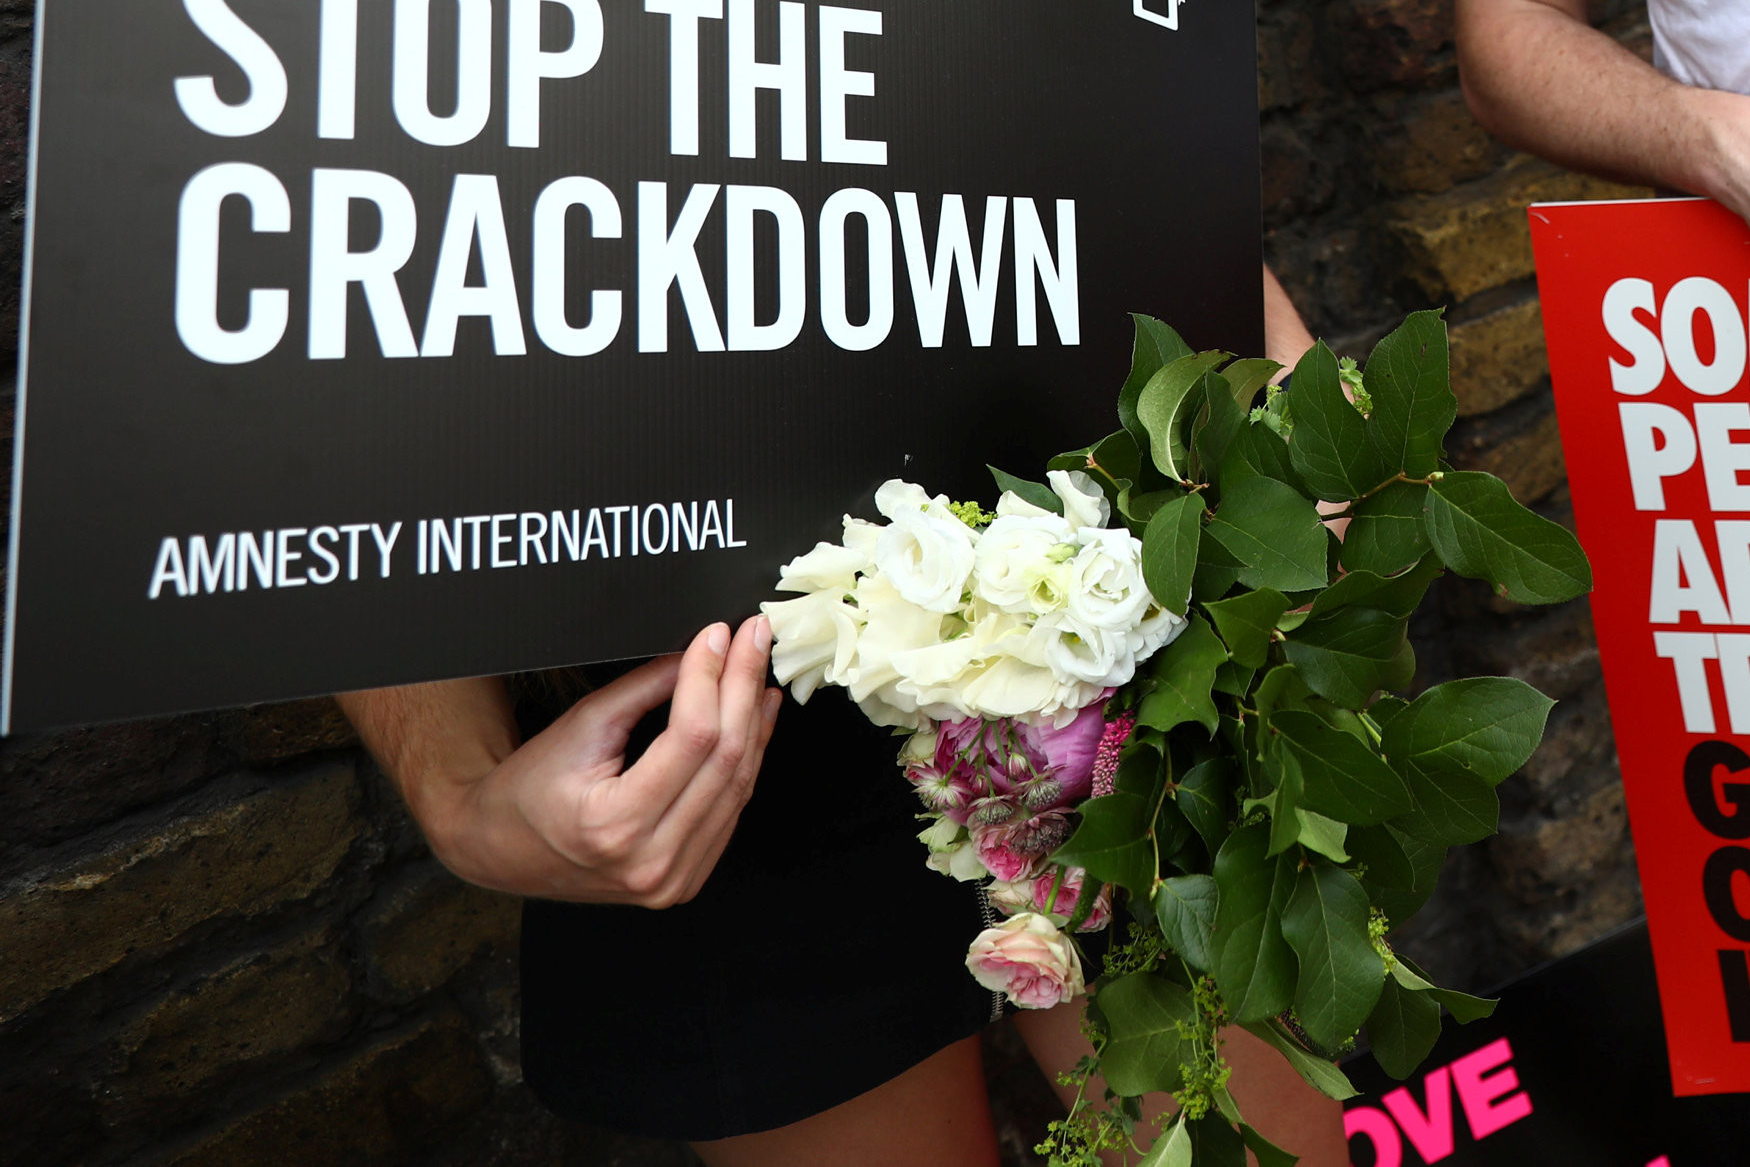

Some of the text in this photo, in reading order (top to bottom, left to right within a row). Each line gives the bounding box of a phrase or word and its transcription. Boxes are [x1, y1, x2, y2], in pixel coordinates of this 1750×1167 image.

[175, 161, 1081, 365] CRACKDOWN
[149, 497, 748, 600] AMNESTY INTERNATIONAL
